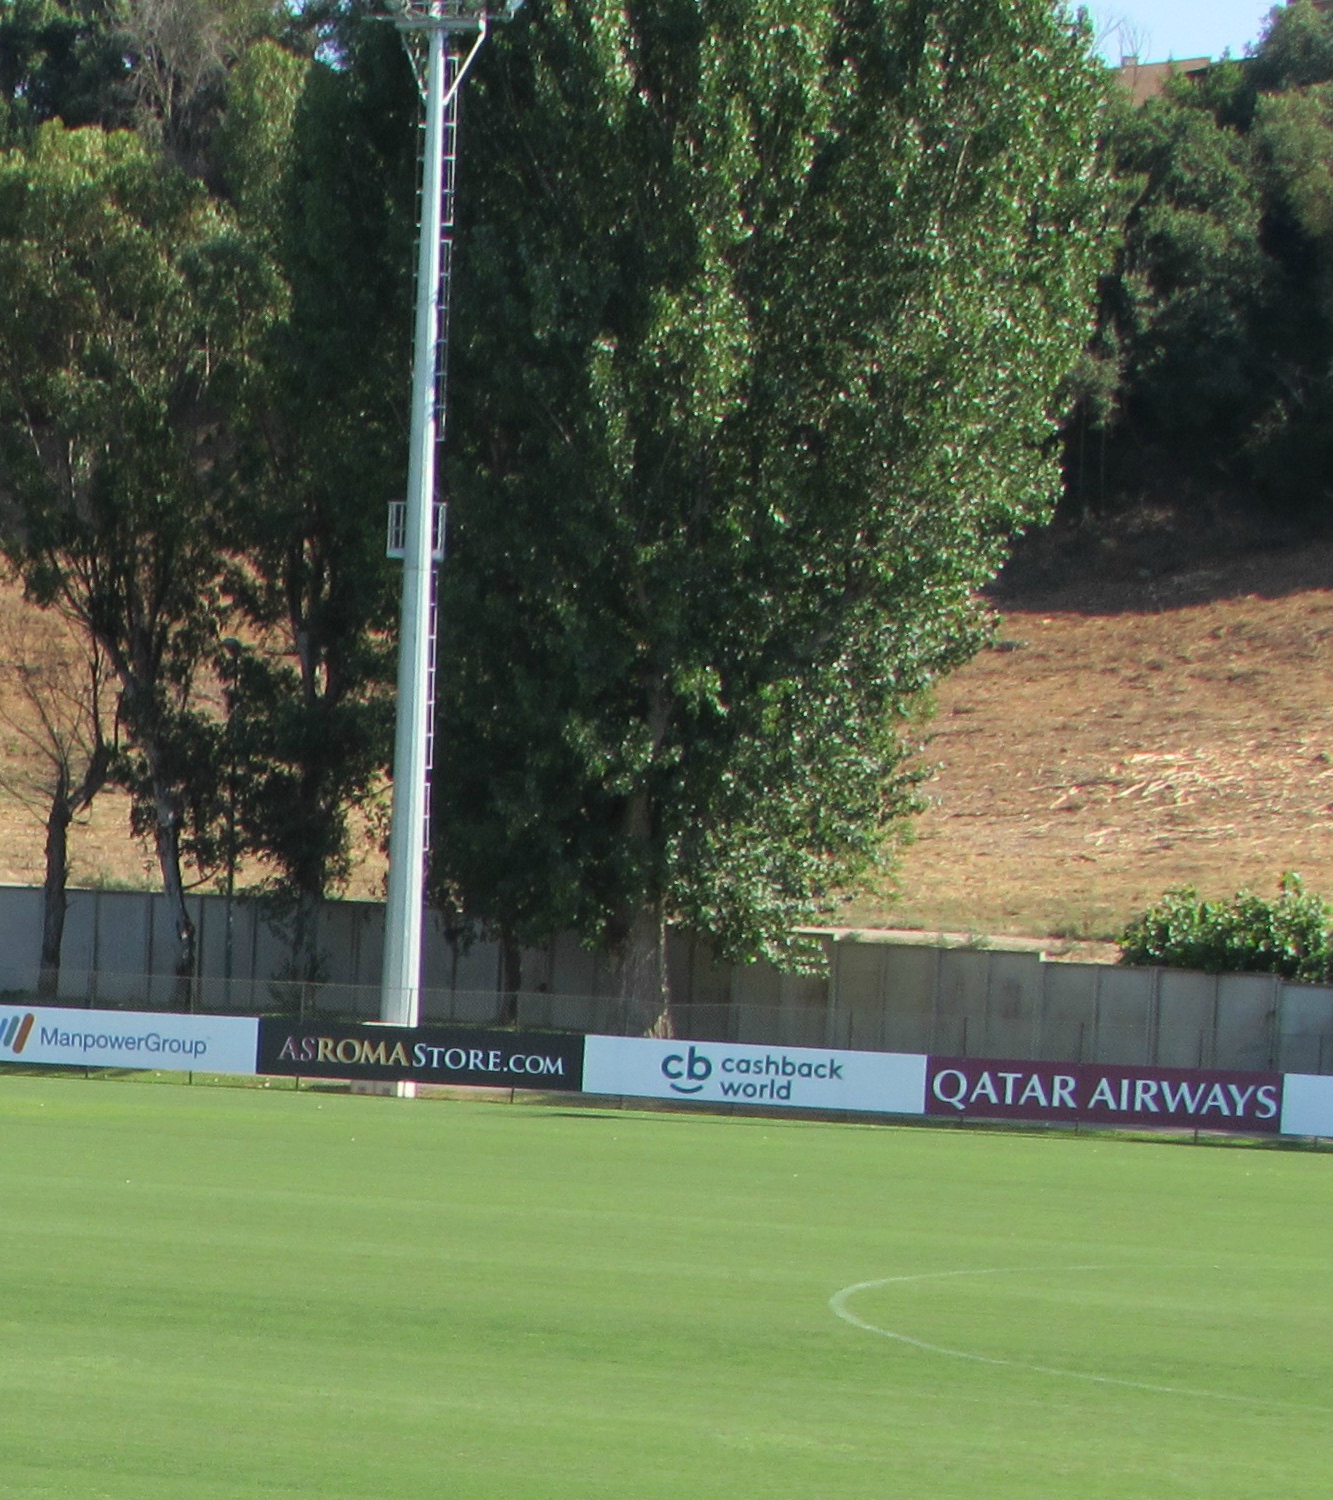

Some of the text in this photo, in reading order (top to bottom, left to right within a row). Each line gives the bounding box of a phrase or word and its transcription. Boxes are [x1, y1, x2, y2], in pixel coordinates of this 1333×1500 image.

[39, 1026, 207, 1058] ManpowerGroup
[661, 1045, 712, 1081] cb
[720, 1053, 844, 1081] cashback
[720, 1076, 792, 1101] world
[932, 1068, 1277, 1119] QATAR AIRWAYS
